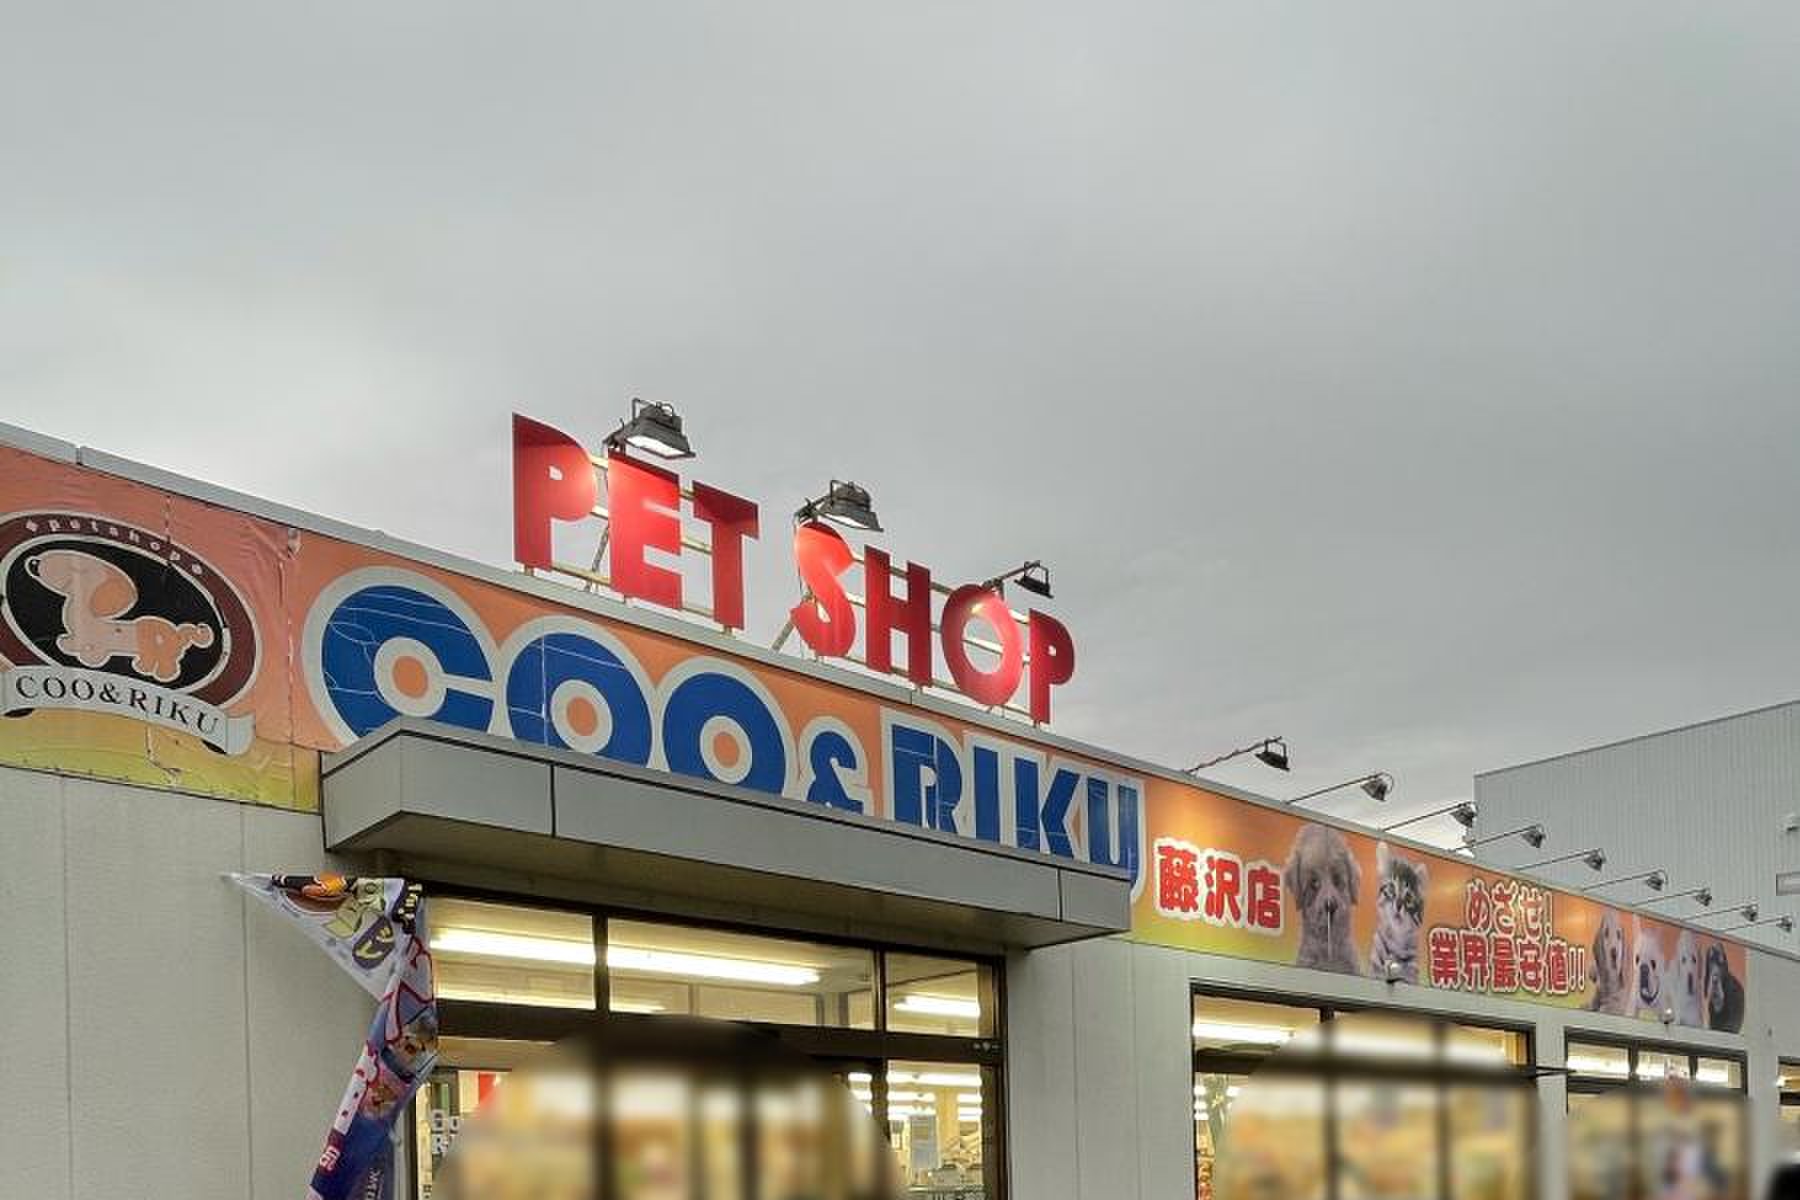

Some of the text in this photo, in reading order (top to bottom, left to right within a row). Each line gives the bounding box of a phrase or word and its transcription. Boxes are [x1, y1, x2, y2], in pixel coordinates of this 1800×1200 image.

[512, 412, 1075, 724] PET SHOP
[15, 675, 219, 734] COO&RIKU
[1155, 842, 1283, 932] 藤沢店
